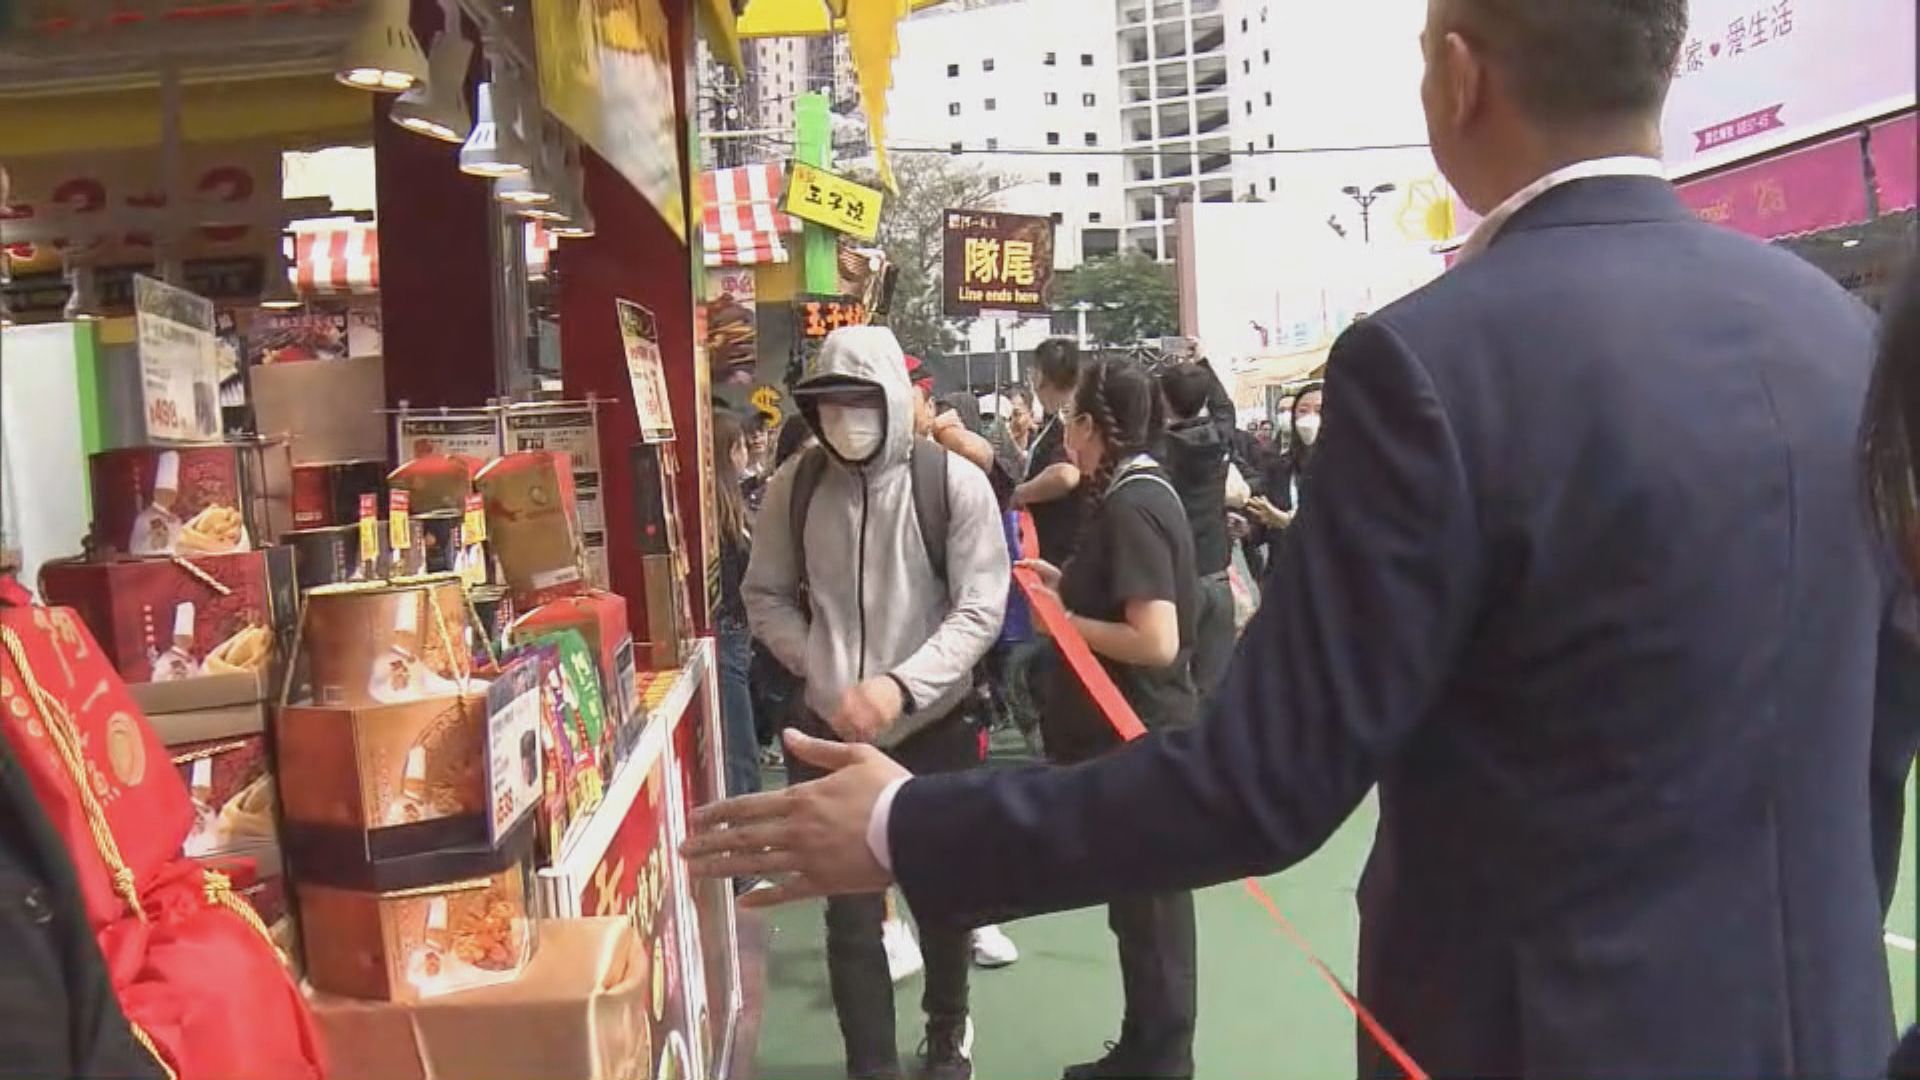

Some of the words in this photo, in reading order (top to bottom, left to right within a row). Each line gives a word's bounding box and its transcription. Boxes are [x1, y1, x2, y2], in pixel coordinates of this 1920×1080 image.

[964, 237, 1035, 286] 隊尾
[958, 286, 983, 301] Line
[985, 288, 1012, 302] ends
[1014, 288, 1040, 304] here
